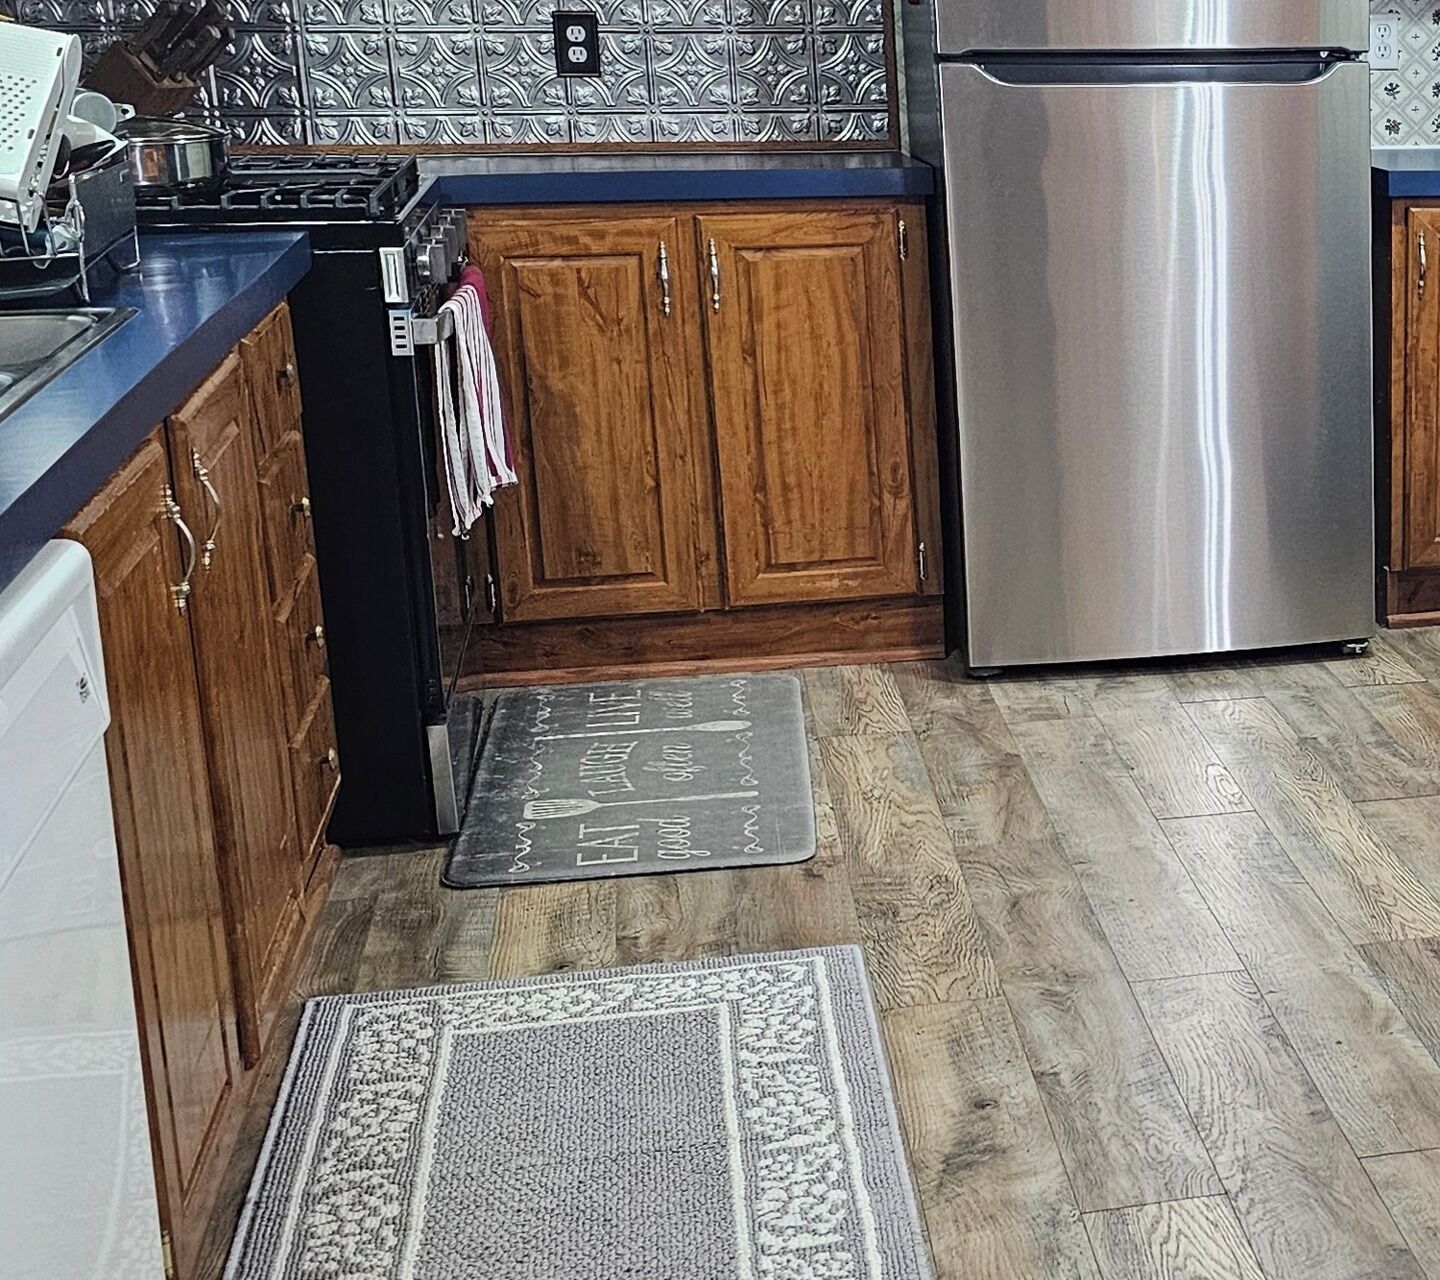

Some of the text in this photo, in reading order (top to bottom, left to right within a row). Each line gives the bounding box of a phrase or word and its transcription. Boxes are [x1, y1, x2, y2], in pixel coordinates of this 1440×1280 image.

[585, 689, 642, 727] LIVE
[648, 690, 693, 718] well
[578, 741, 639, 797] LAUGH
[641, 742, 707, 782] often
[576, 823, 640, 866] EAT
[636, 814, 711, 860] good
